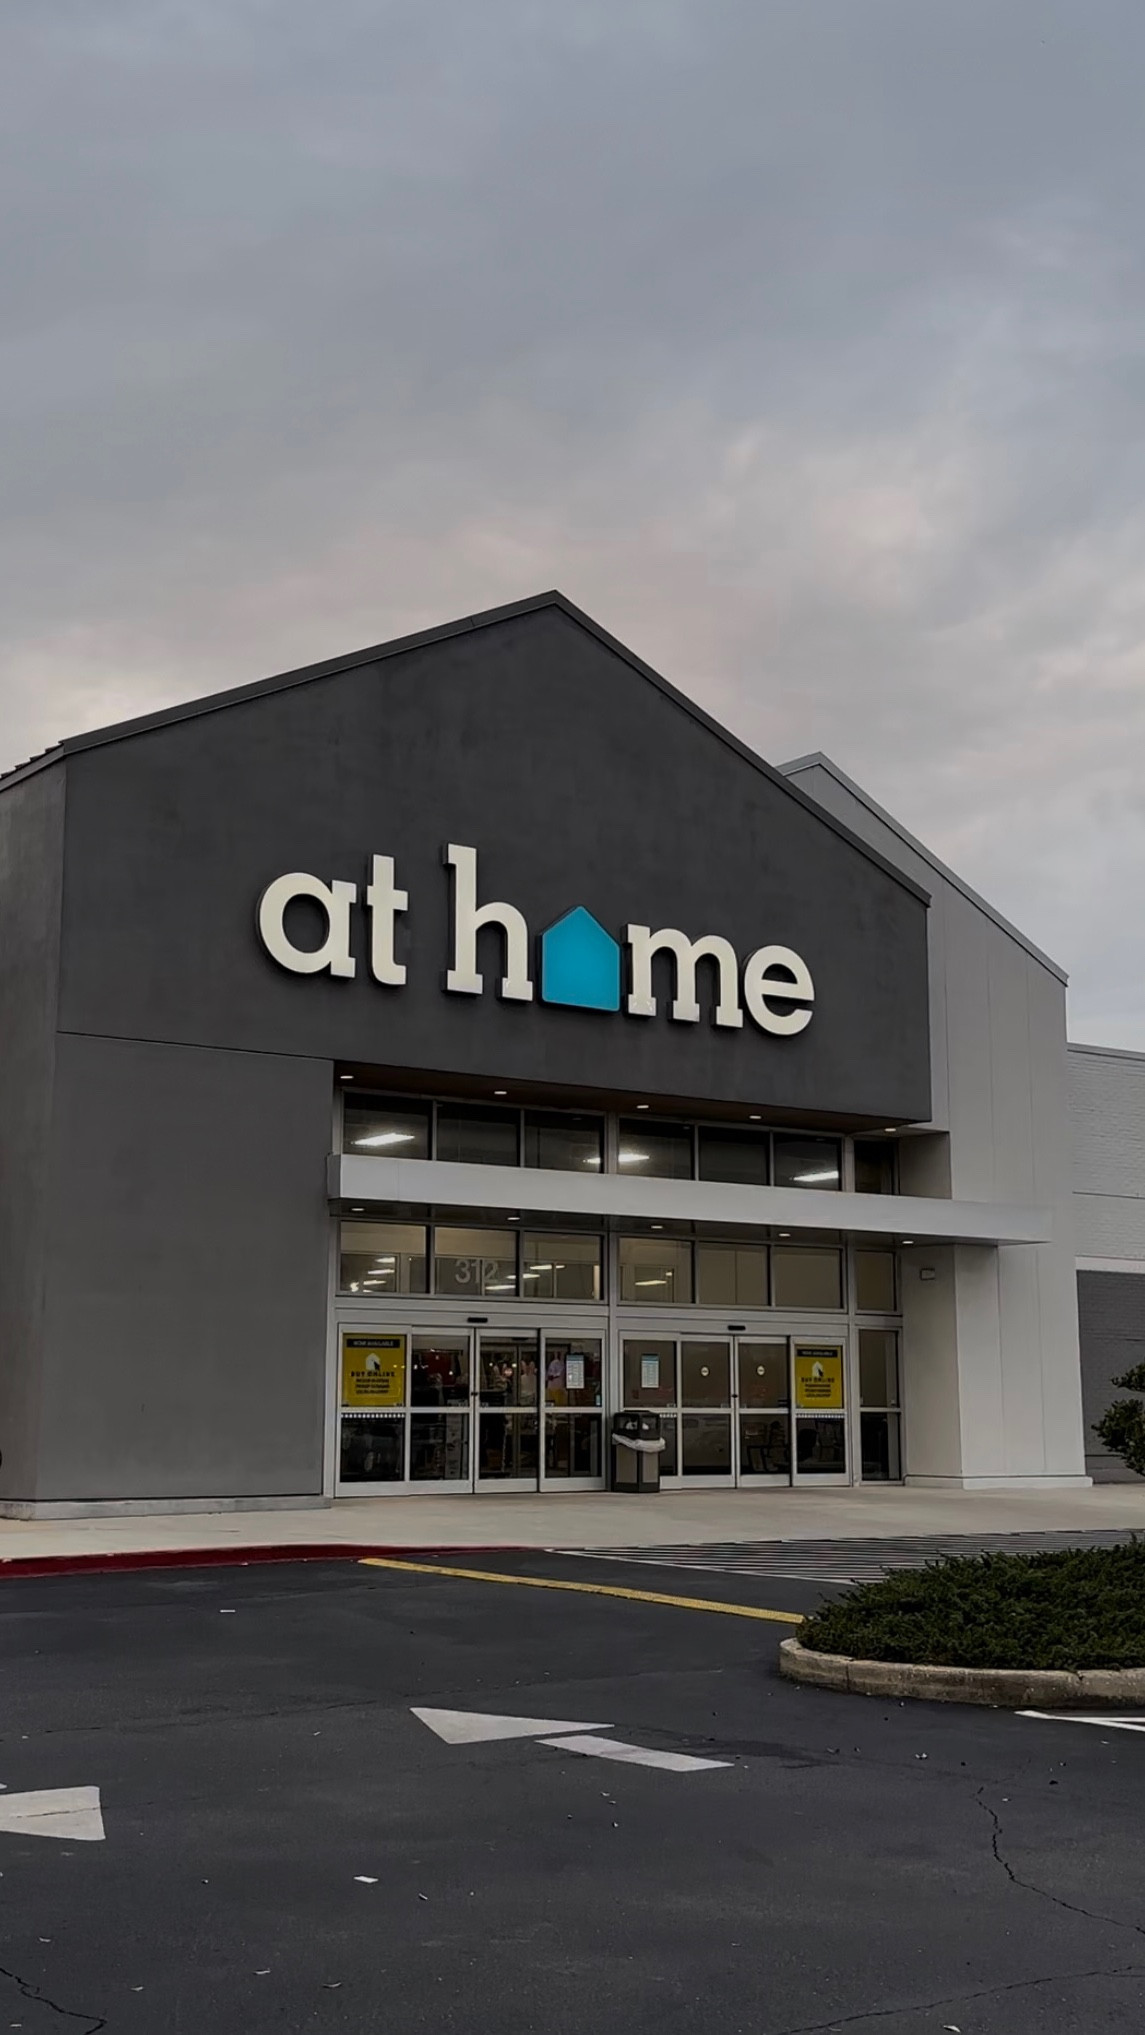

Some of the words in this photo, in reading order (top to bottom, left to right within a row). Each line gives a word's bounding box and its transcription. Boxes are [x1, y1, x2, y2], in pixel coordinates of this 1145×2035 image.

[258, 853, 408, 986] at
[442, 842, 815, 1037] hme
[455, 1258, 499, 1284] 312
